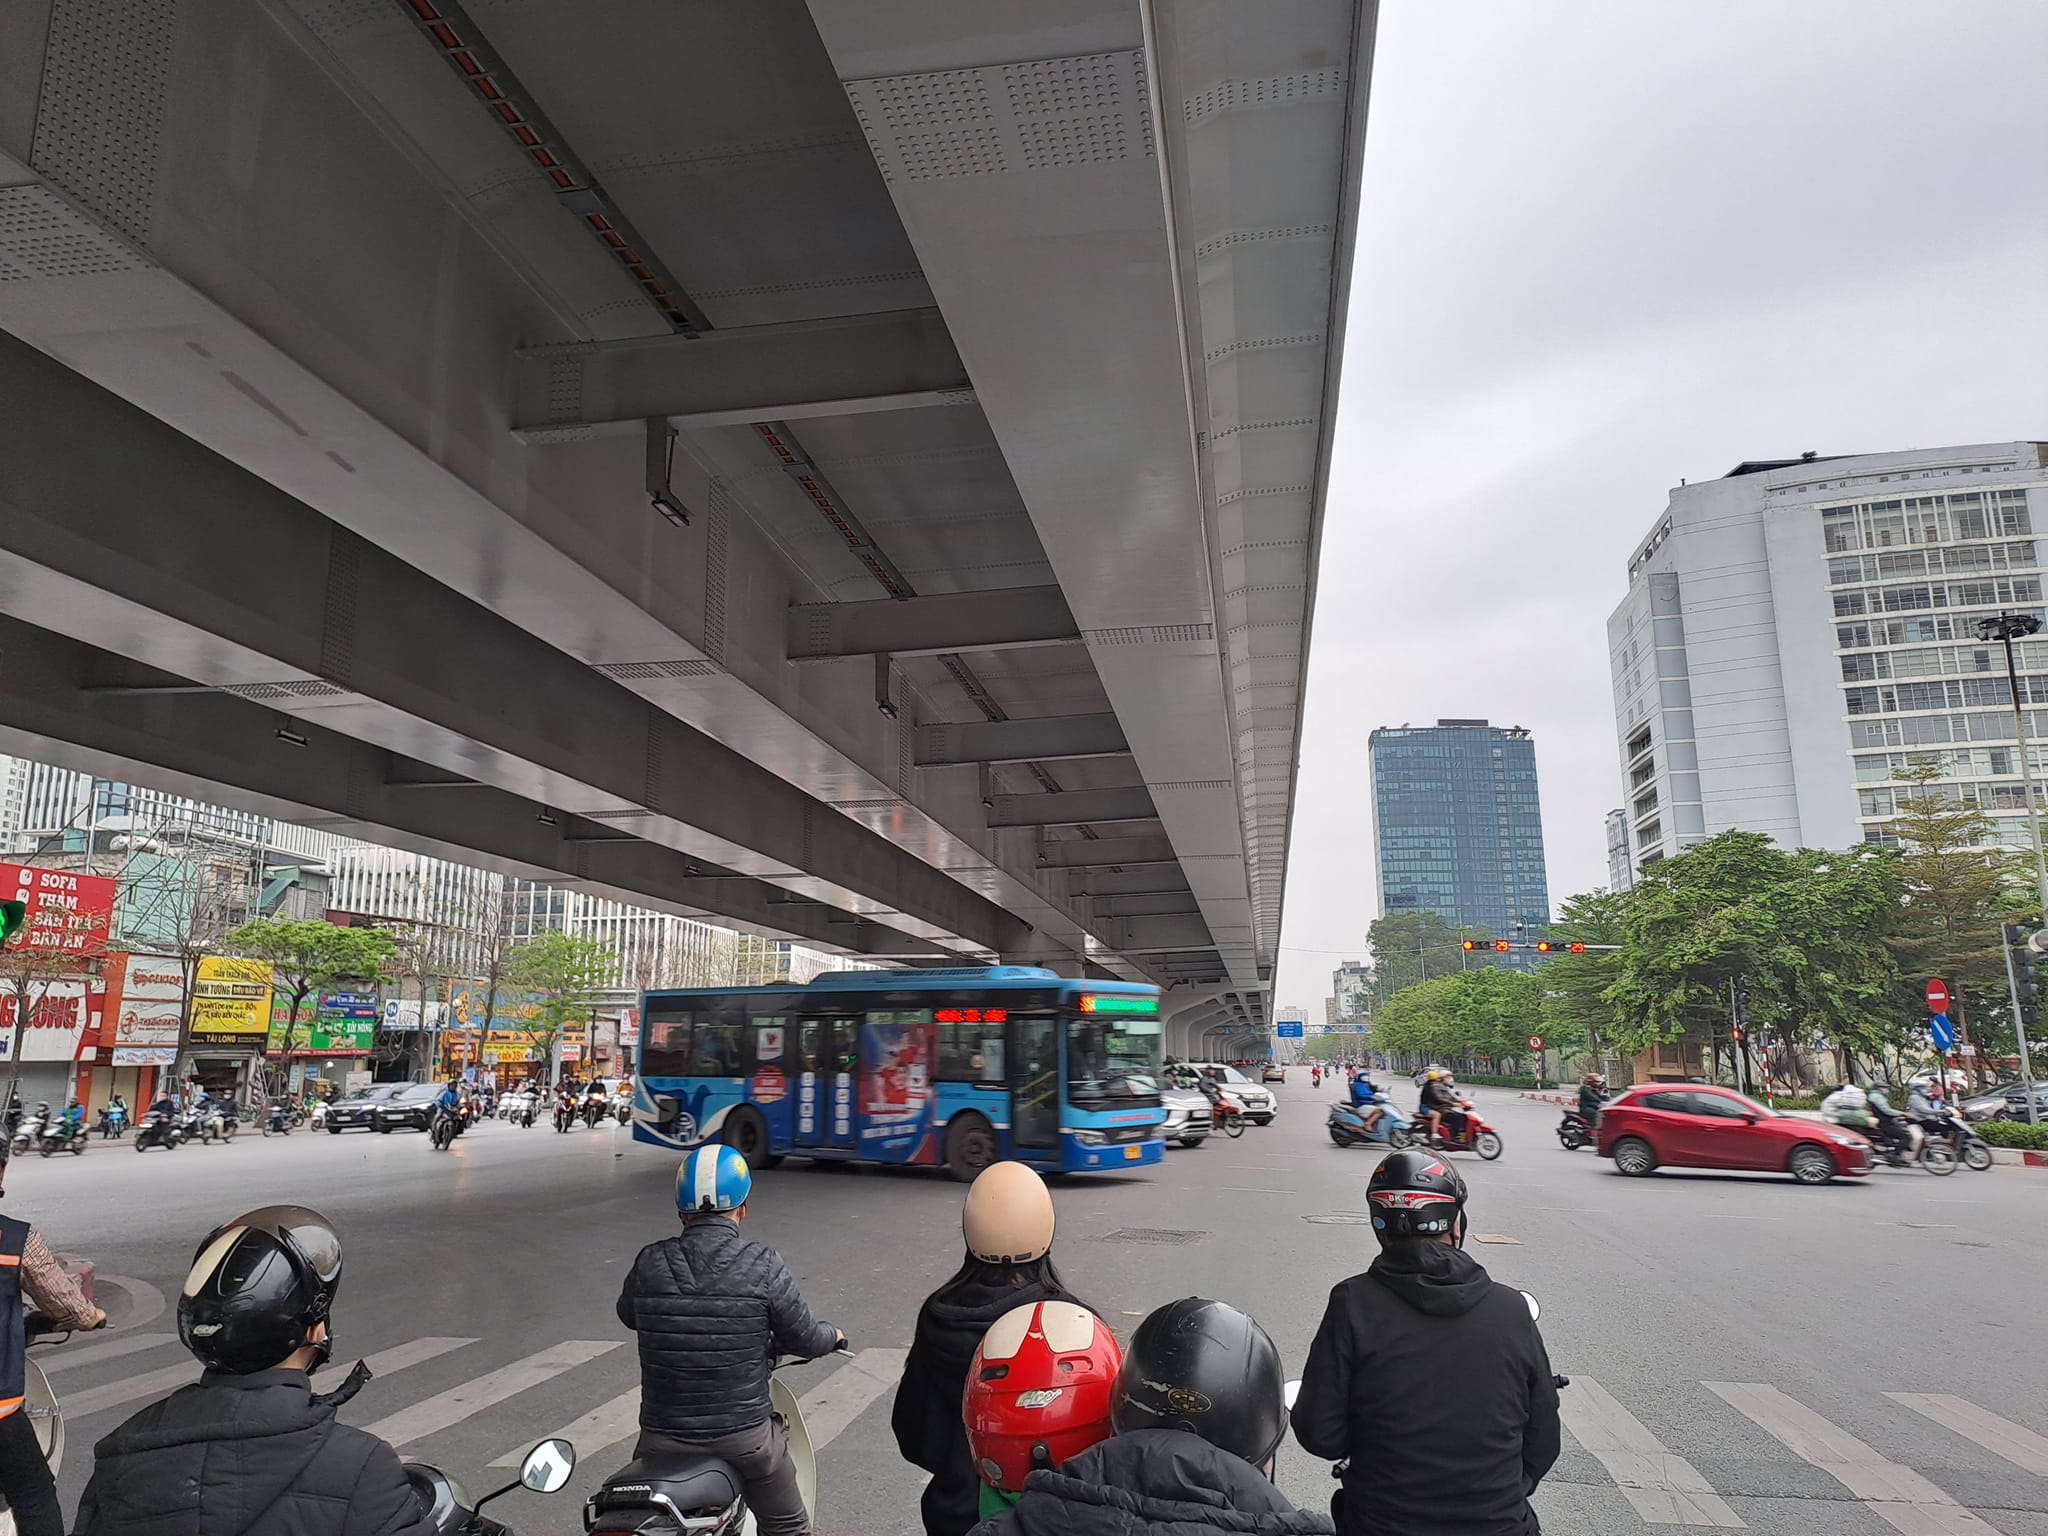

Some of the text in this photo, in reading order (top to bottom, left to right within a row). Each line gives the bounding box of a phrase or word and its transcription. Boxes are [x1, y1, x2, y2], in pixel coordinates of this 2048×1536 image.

[40, 873, 77, 891] SOFA
[1496, 941, 1508, 951] 29
[1571, 942, 1584, 953] 29
